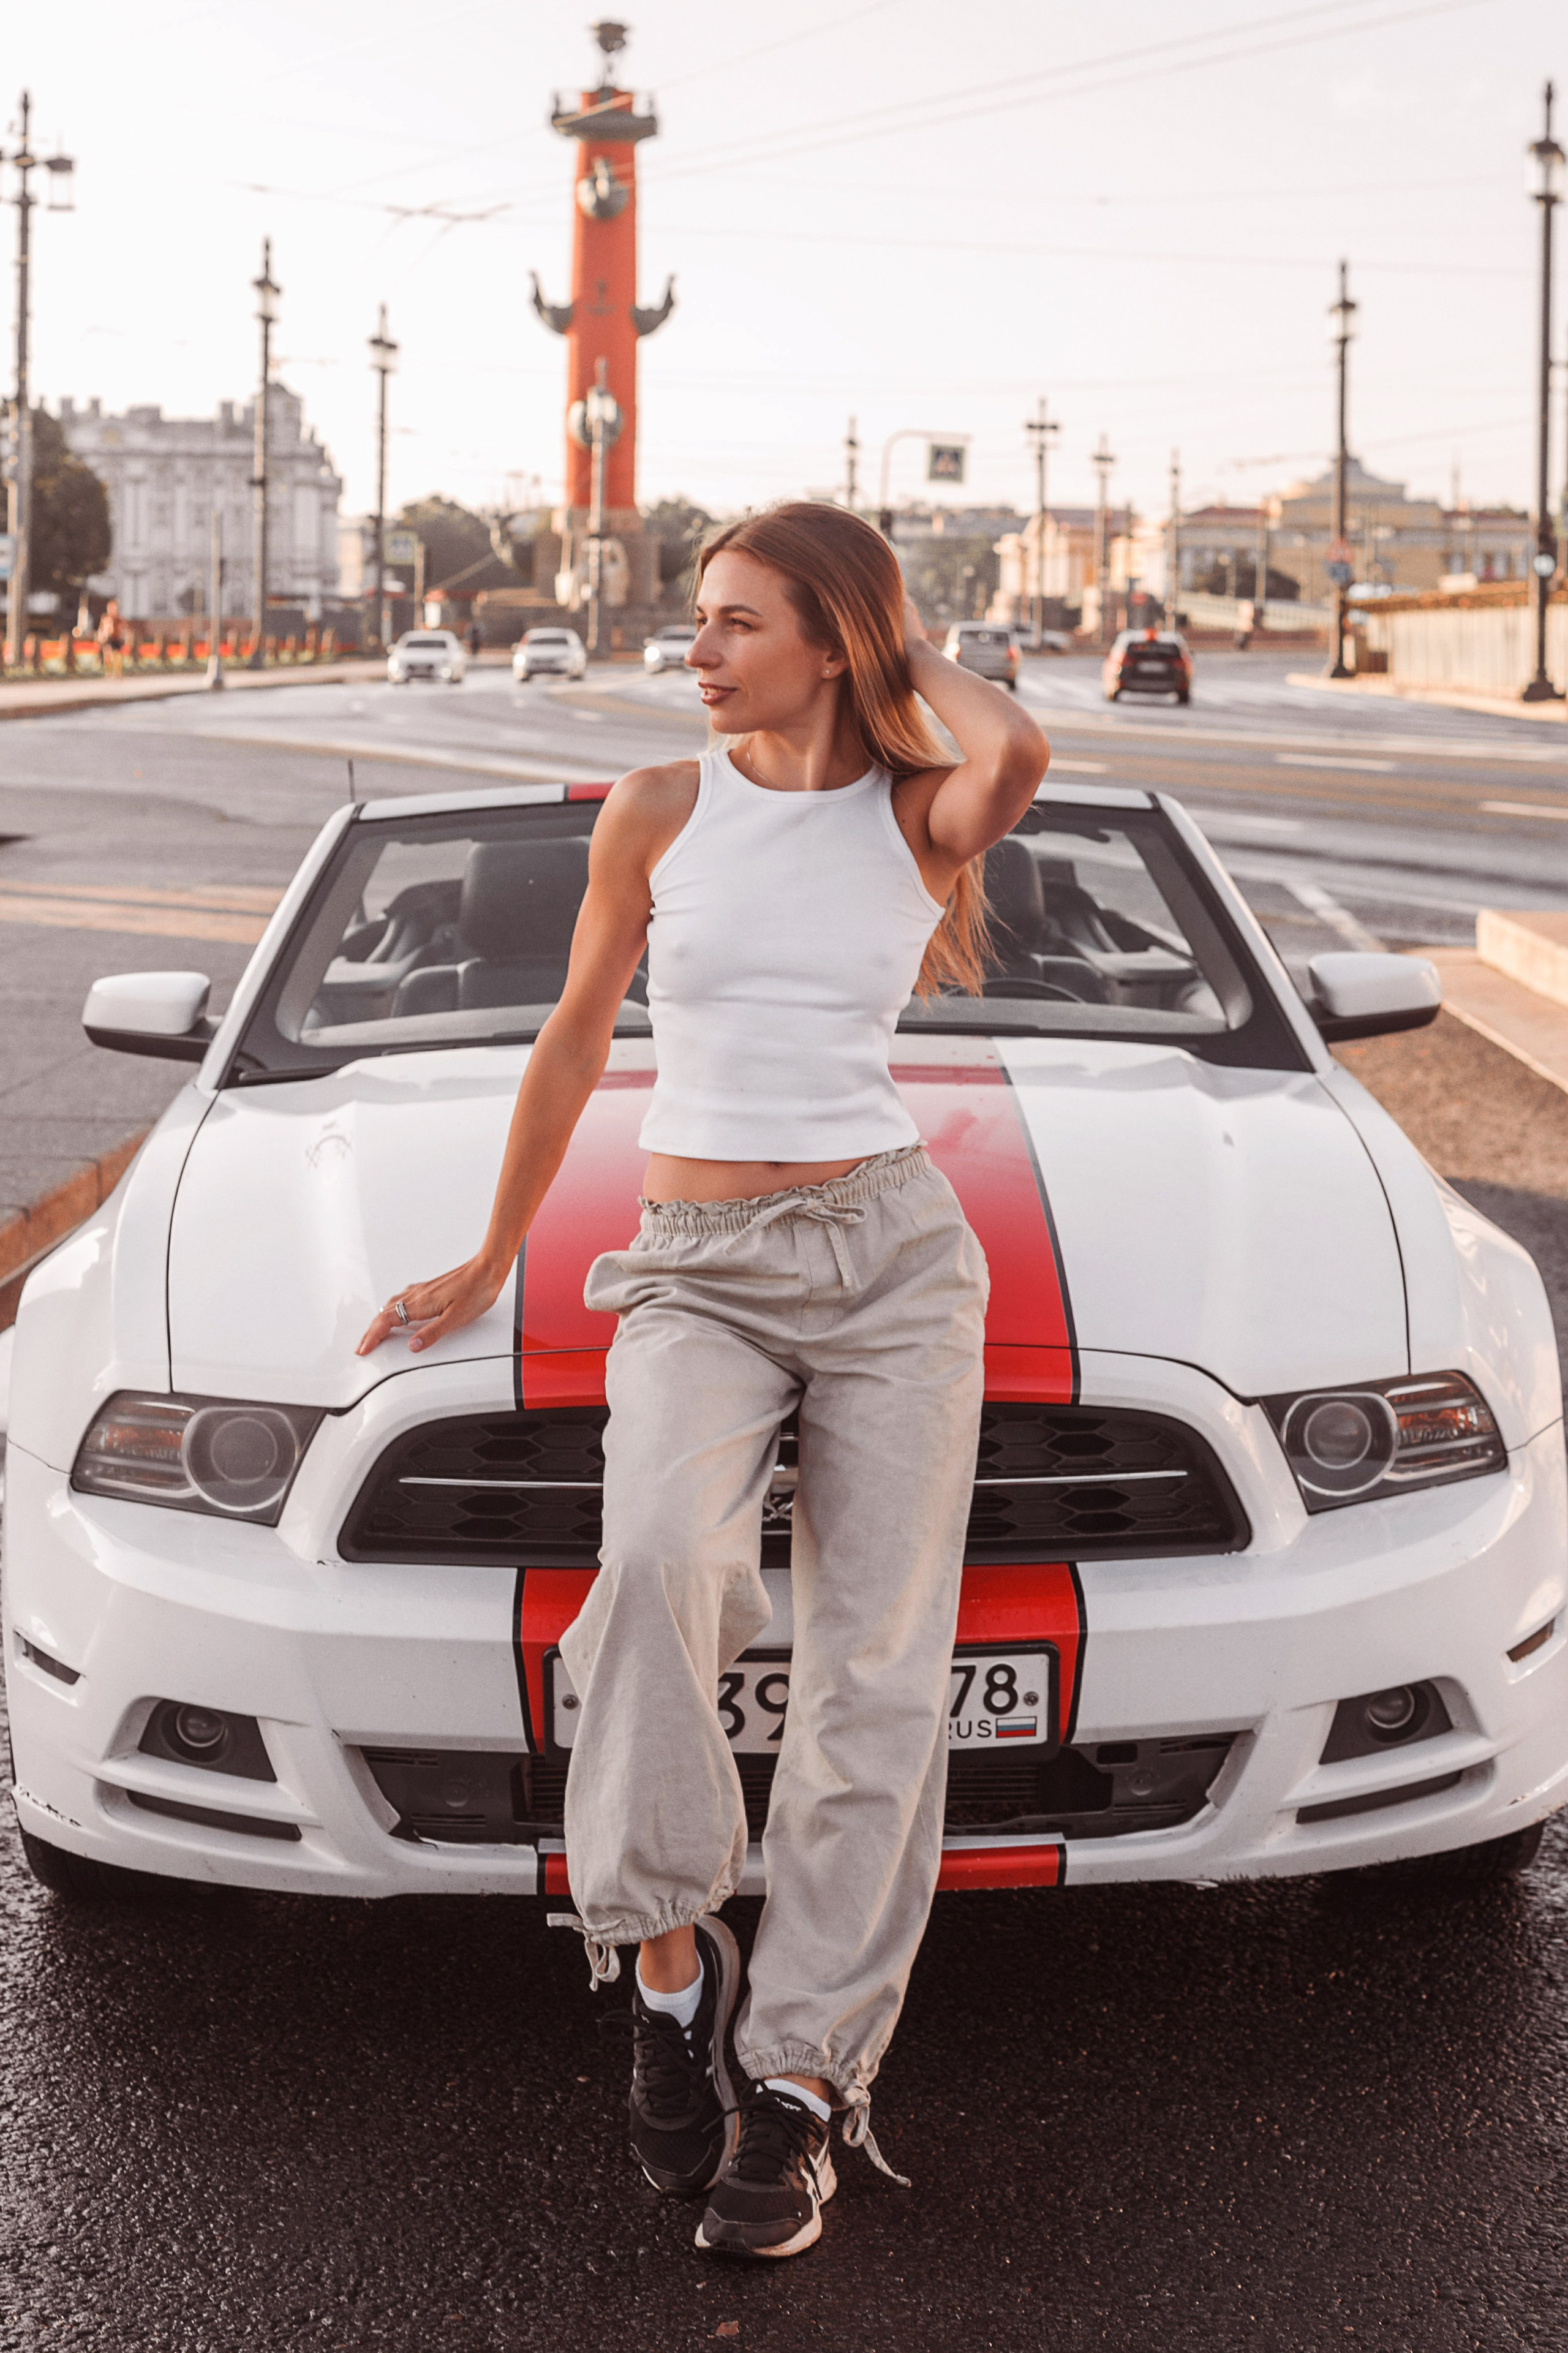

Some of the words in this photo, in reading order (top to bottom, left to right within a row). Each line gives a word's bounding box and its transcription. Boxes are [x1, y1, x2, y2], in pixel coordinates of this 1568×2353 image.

[718, 1672, 790, 1740] 39
[951, 1663, 1018, 1717] 78
[949, 1720, 992, 1740] US
